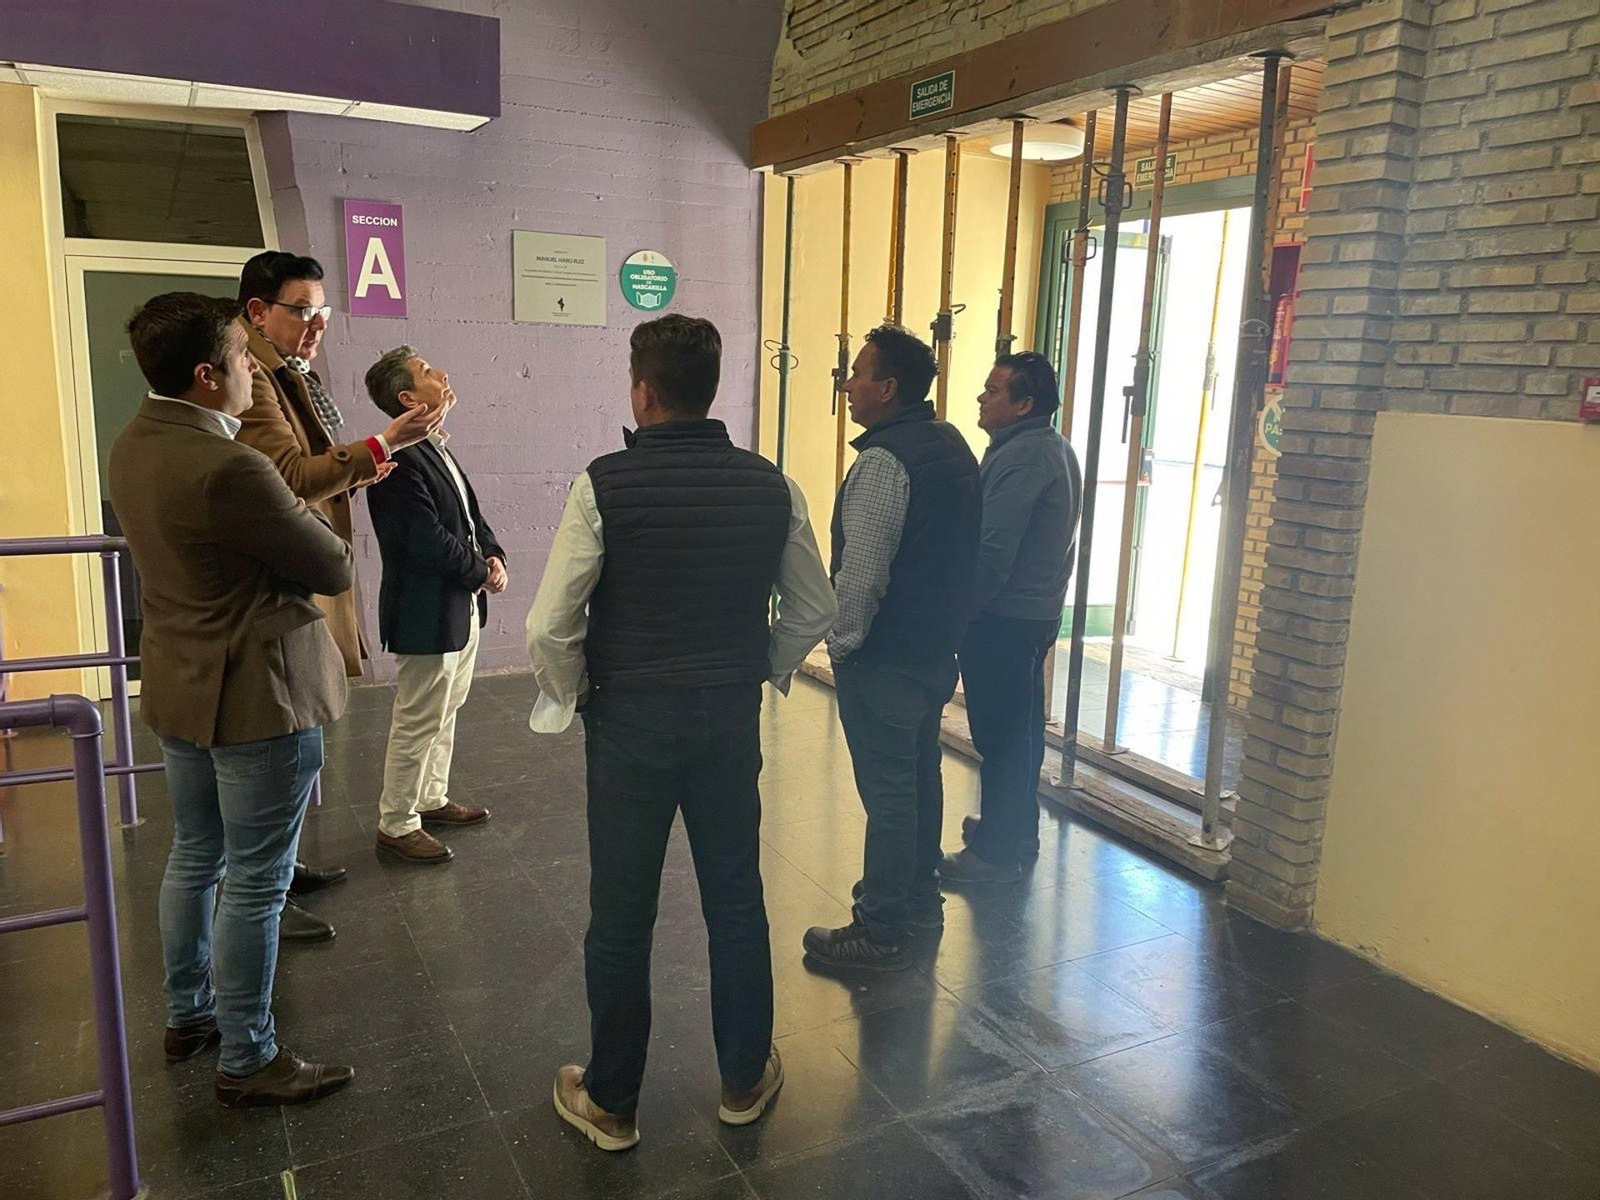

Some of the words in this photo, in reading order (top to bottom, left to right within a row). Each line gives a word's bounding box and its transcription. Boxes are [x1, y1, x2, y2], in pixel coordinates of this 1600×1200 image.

[916, 83, 938, 98] SALIDA
[939, 79, 949, 92] DE
[912, 92, 951, 112] EMERGENCIA
[352, 215, 398, 227] SECCION
[354, 237, 402, 299] A
[629, 274, 668, 282] OBLIGATORIO
